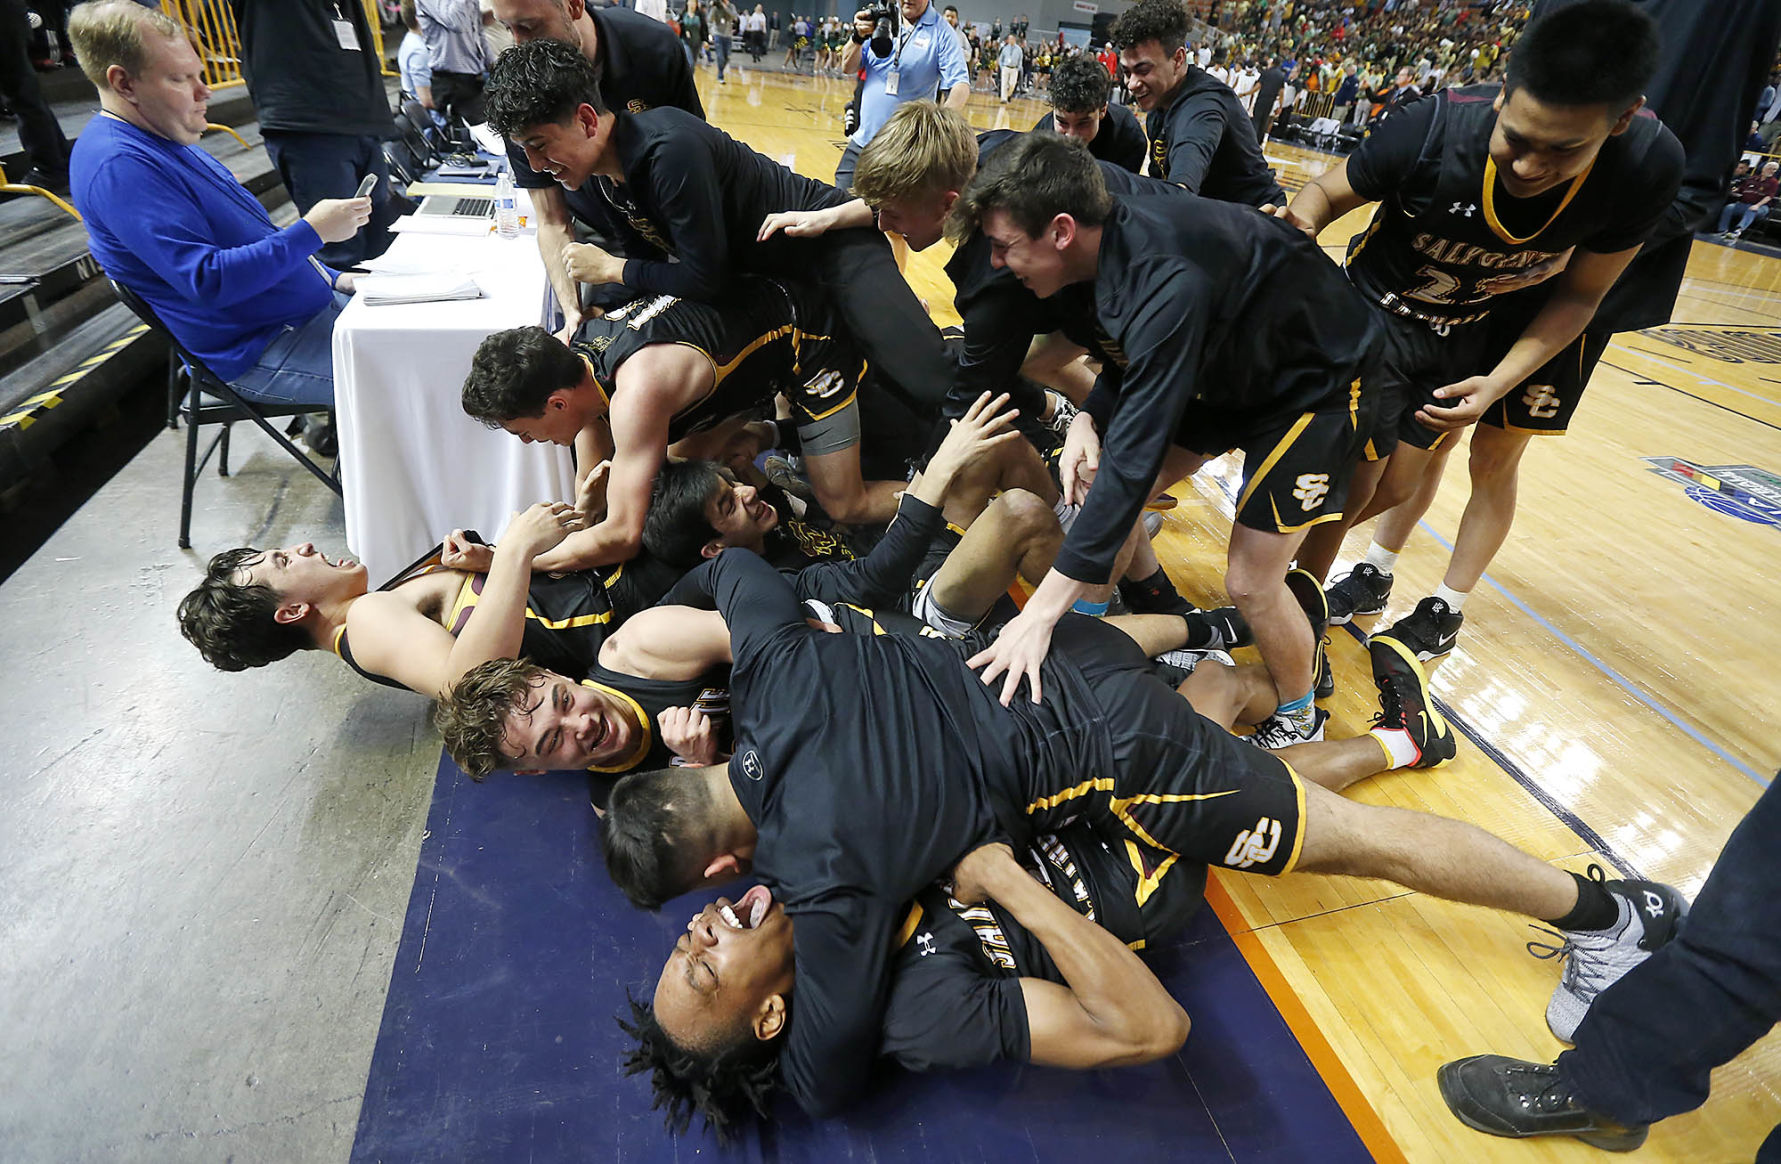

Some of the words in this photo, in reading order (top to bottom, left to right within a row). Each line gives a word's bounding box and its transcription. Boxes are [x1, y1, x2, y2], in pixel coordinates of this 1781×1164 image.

[1521, 385, 1561, 418] SC
[1292, 473, 1330, 512] SC
[1224, 816, 1282, 868] SC
